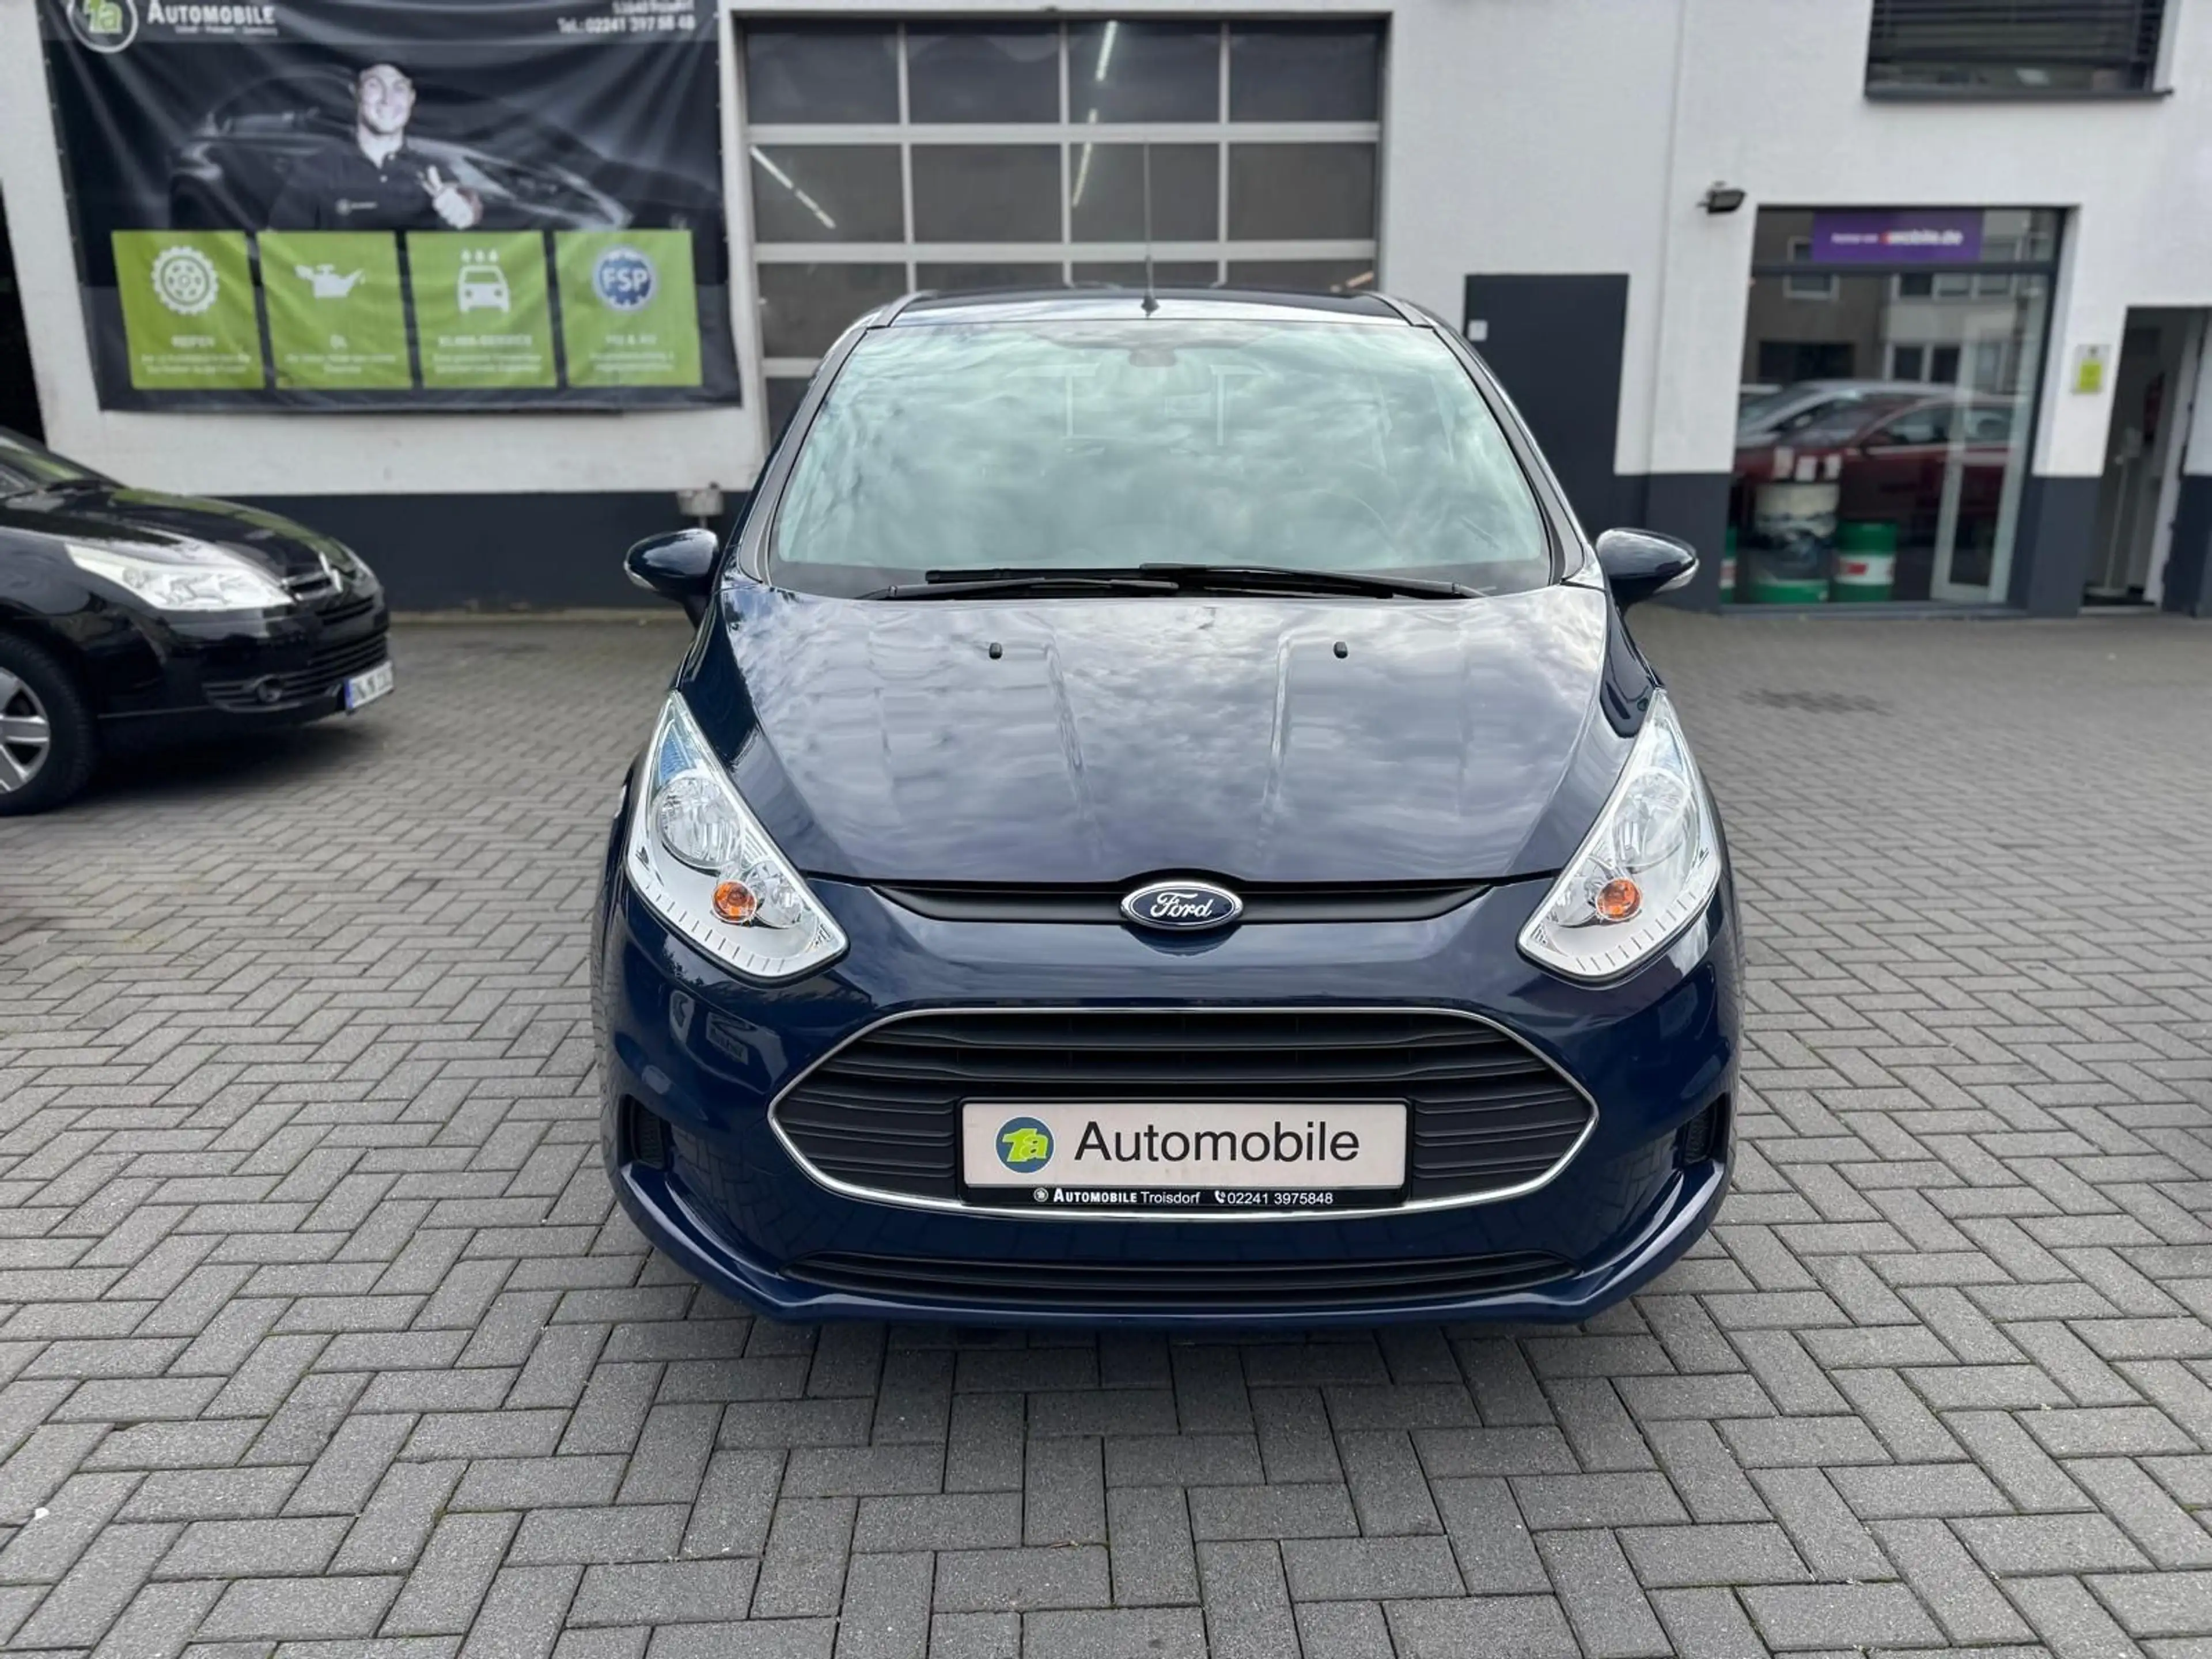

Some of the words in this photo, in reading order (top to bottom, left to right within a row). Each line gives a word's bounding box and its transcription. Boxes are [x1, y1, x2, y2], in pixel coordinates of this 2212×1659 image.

[601, 267, 648, 292] FSP
[1150, 892, 1213, 918] Ford
[1002, 1128, 1049, 1162] 1a
[1074, 1121, 1359, 1162] Automobile
[1140, 1191, 1200, 1205] Troisdorf
[1228, 1192, 1268, 1204] 02241
[1274, 1192, 1334, 1205] 3975848
